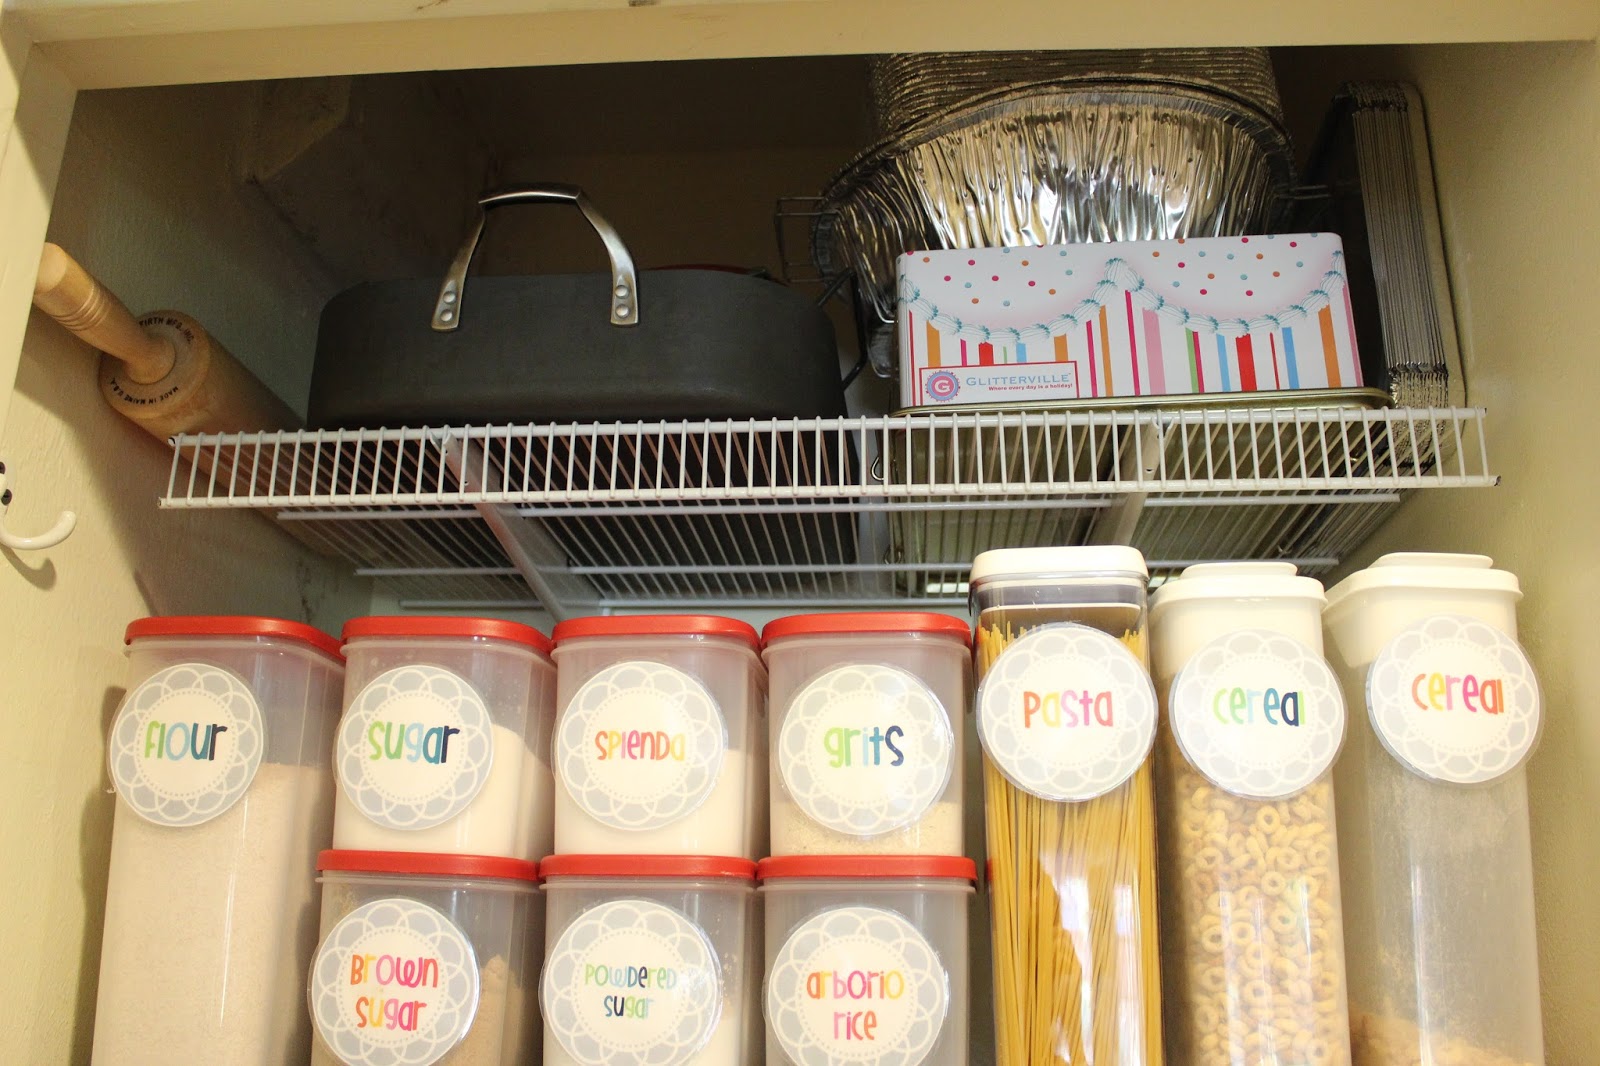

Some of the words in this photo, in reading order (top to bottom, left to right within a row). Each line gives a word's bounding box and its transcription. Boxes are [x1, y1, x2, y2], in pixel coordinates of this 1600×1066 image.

[160, 386, 179, 402] MADE
[966, 374, 1070, 386] GLITTERVILLE
[1213, 687, 1306, 727] cereal
[1411, 672, 1504, 715] cereal
[144, 720, 228, 761] flour
[368, 720, 461, 764] sugar
[806, 970, 905, 1000] arborio
[355, 996, 427, 1031] sugar
[603, 995, 655, 1019] sugar
[833, 1010, 877, 1041] rice
